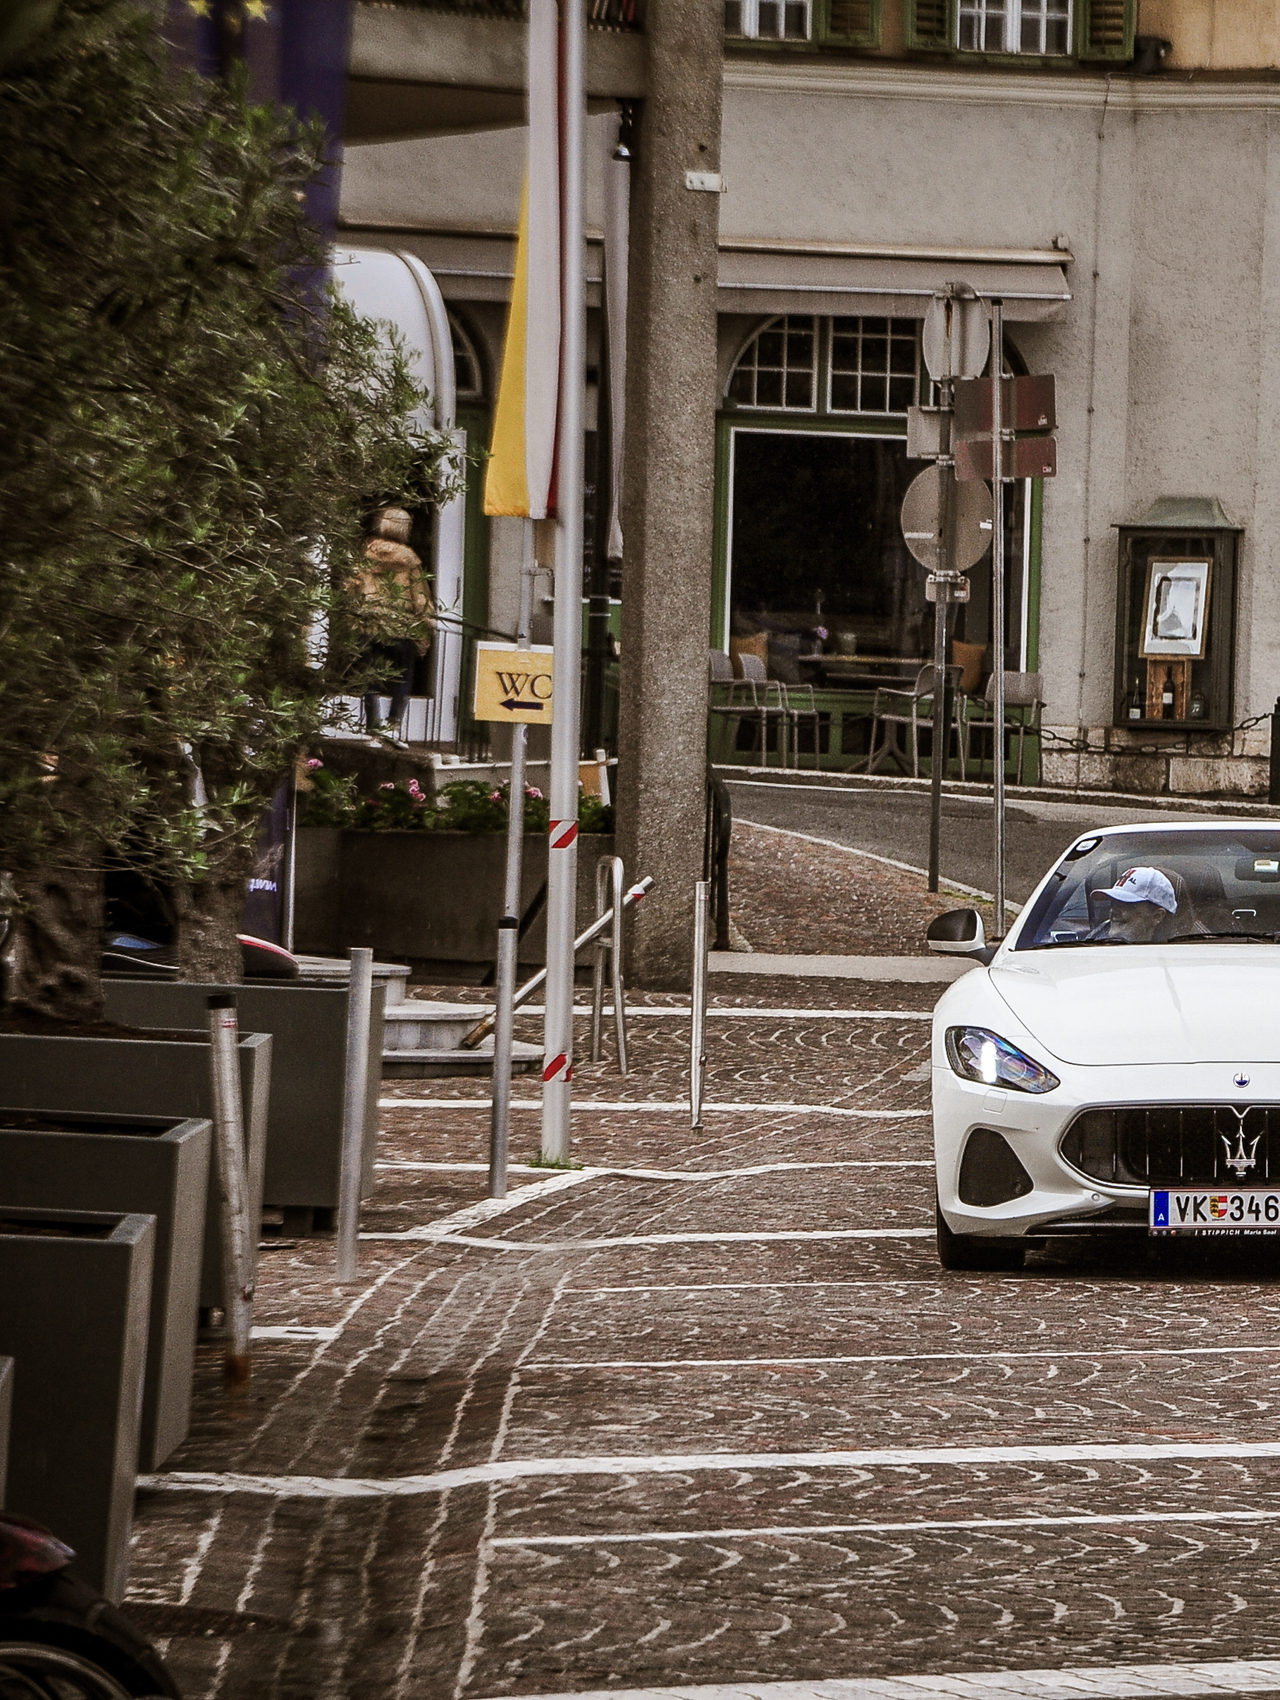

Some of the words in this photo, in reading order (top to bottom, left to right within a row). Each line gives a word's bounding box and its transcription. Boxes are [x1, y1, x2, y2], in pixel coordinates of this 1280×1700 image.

[495, 671, 553, 699] WC
[1156, 1212, 1166, 1222] A
[1175, 1195, 1208, 1223] VK
[1229, 1195, 1280, 1222] 346
